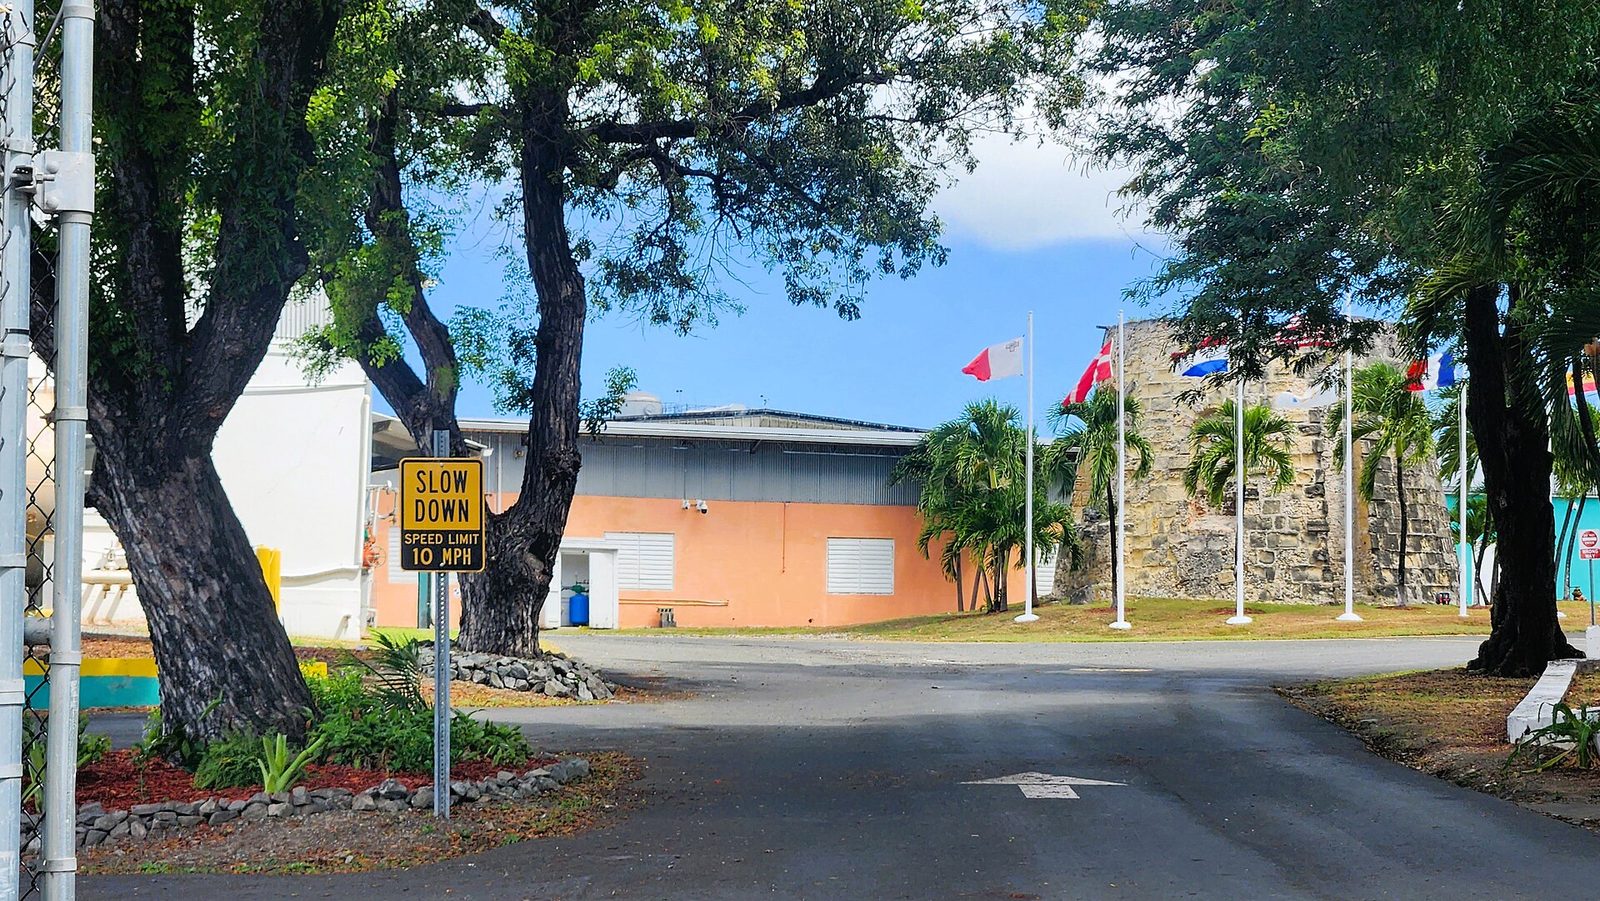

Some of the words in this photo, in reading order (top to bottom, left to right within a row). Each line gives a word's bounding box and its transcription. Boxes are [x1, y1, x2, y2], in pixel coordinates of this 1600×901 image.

[416, 470, 467, 493] SLOW
[415, 499, 469, 522] DOWN
[404, 533, 443, 545] SPEED
[448, 533, 479, 545] LIMIT
[413, 547, 433, 566] 10
[442, 547, 472, 566] MPH
